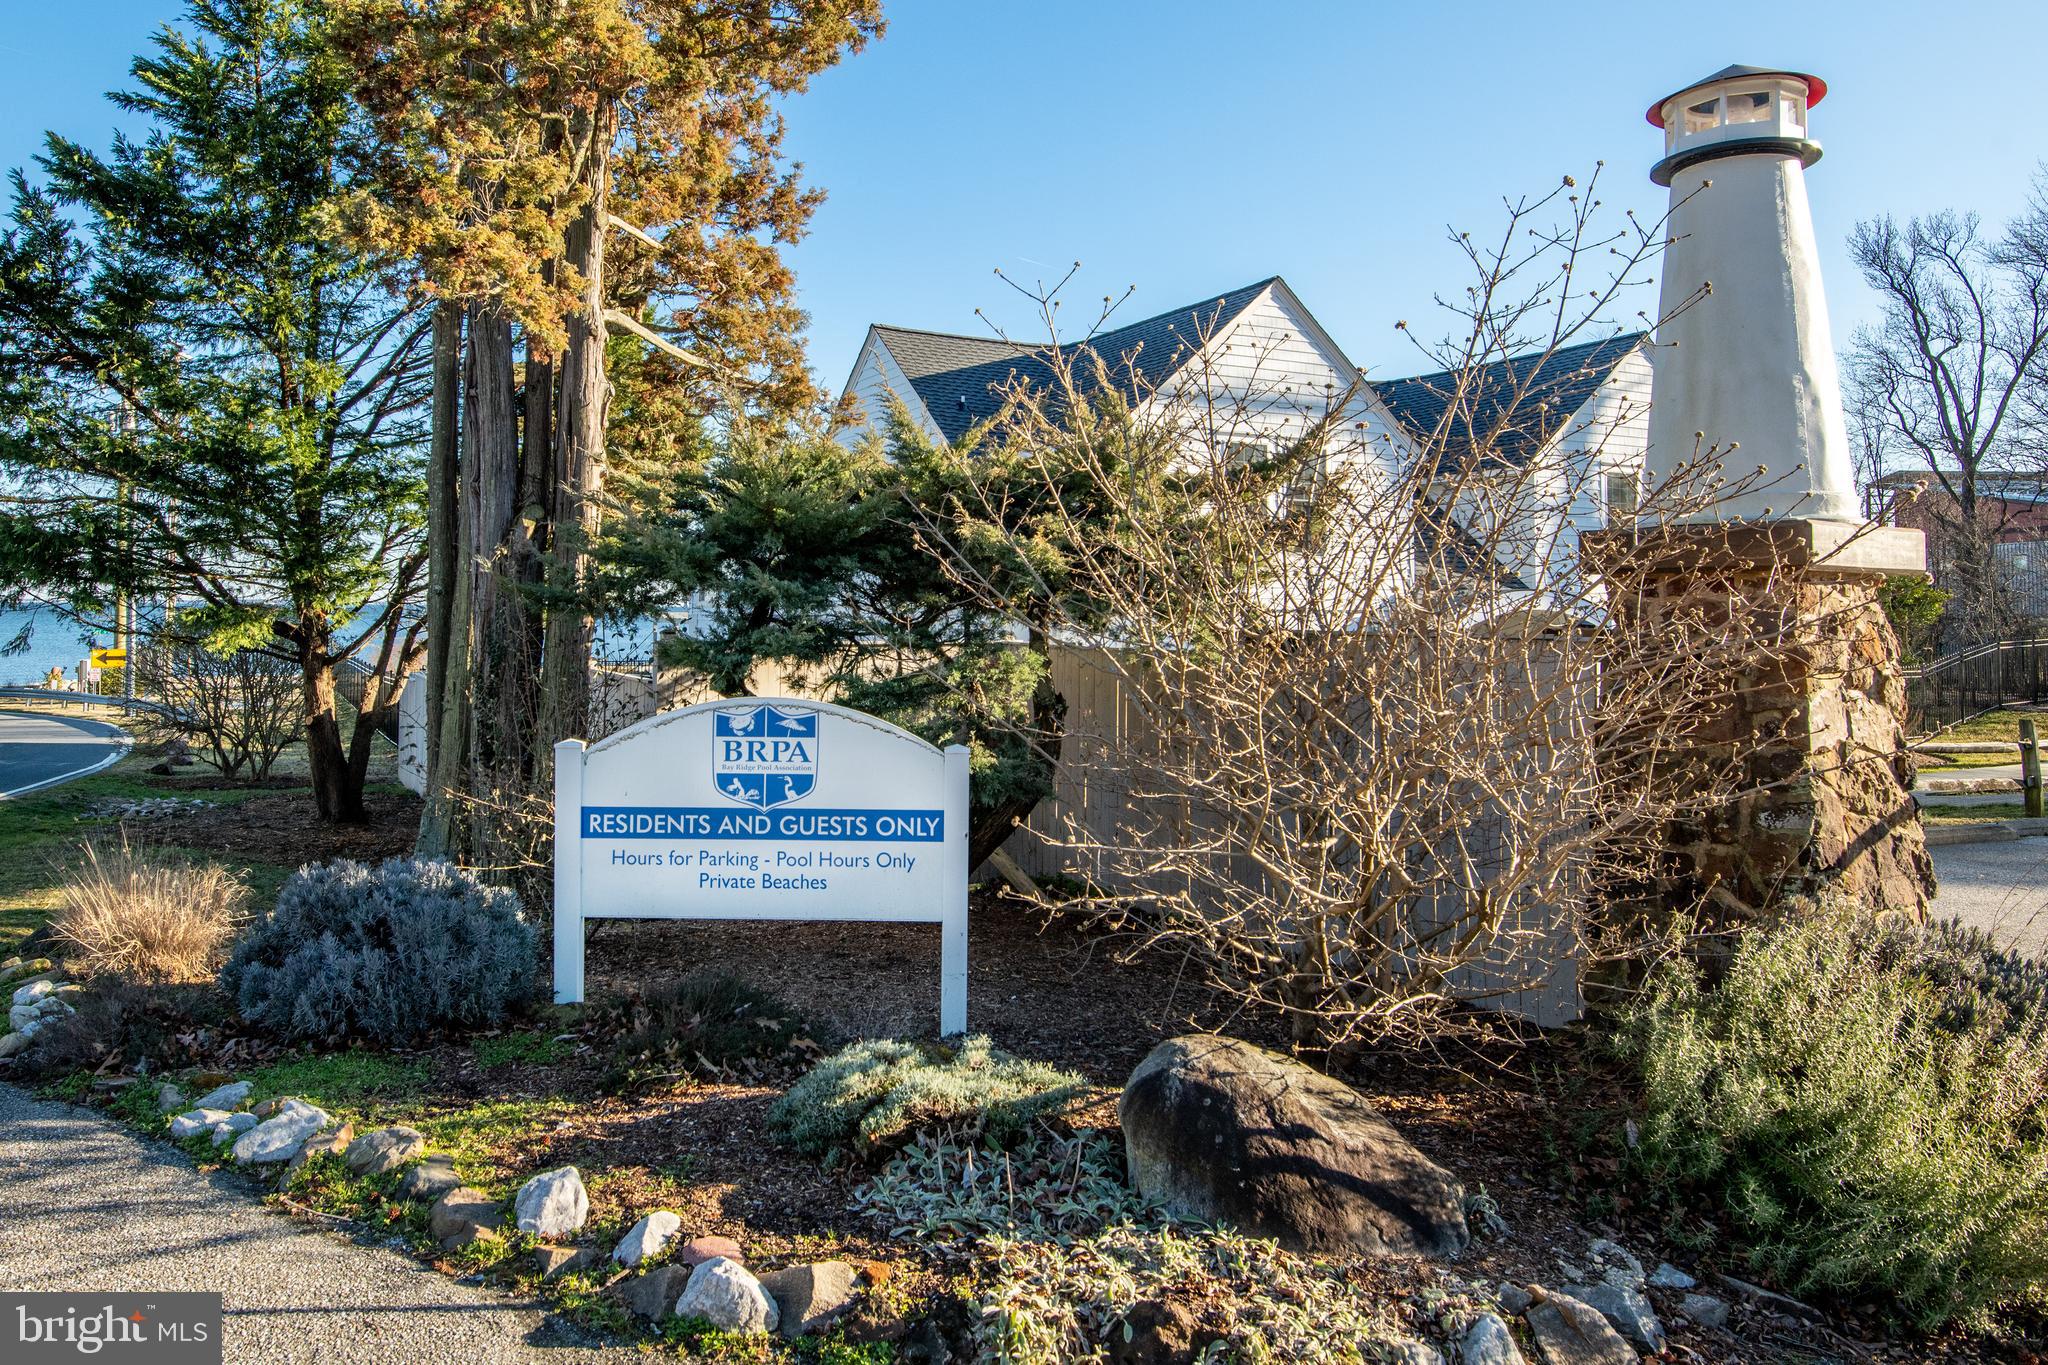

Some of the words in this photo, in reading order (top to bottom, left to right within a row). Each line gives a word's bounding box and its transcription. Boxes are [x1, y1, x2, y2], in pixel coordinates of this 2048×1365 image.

[723, 740, 812, 763] BRPA
[589, 813, 710, 835] RESIDENTS
[717, 814, 771, 835] AND
[779, 815, 868, 836] GUESTS
[876, 815, 940, 837] ONLY
[612, 850, 663, 866] Hours
[668, 850, 693, 867] for
[699, 851, 759, 871] Parking
[777, 852, 813, 868] Pool
[819, 852, 869, 868] Hours
[876, 852, 916, 873] Only
[699, 873, 756, 889] Private
[762, 874, 827, 890] Beaches
